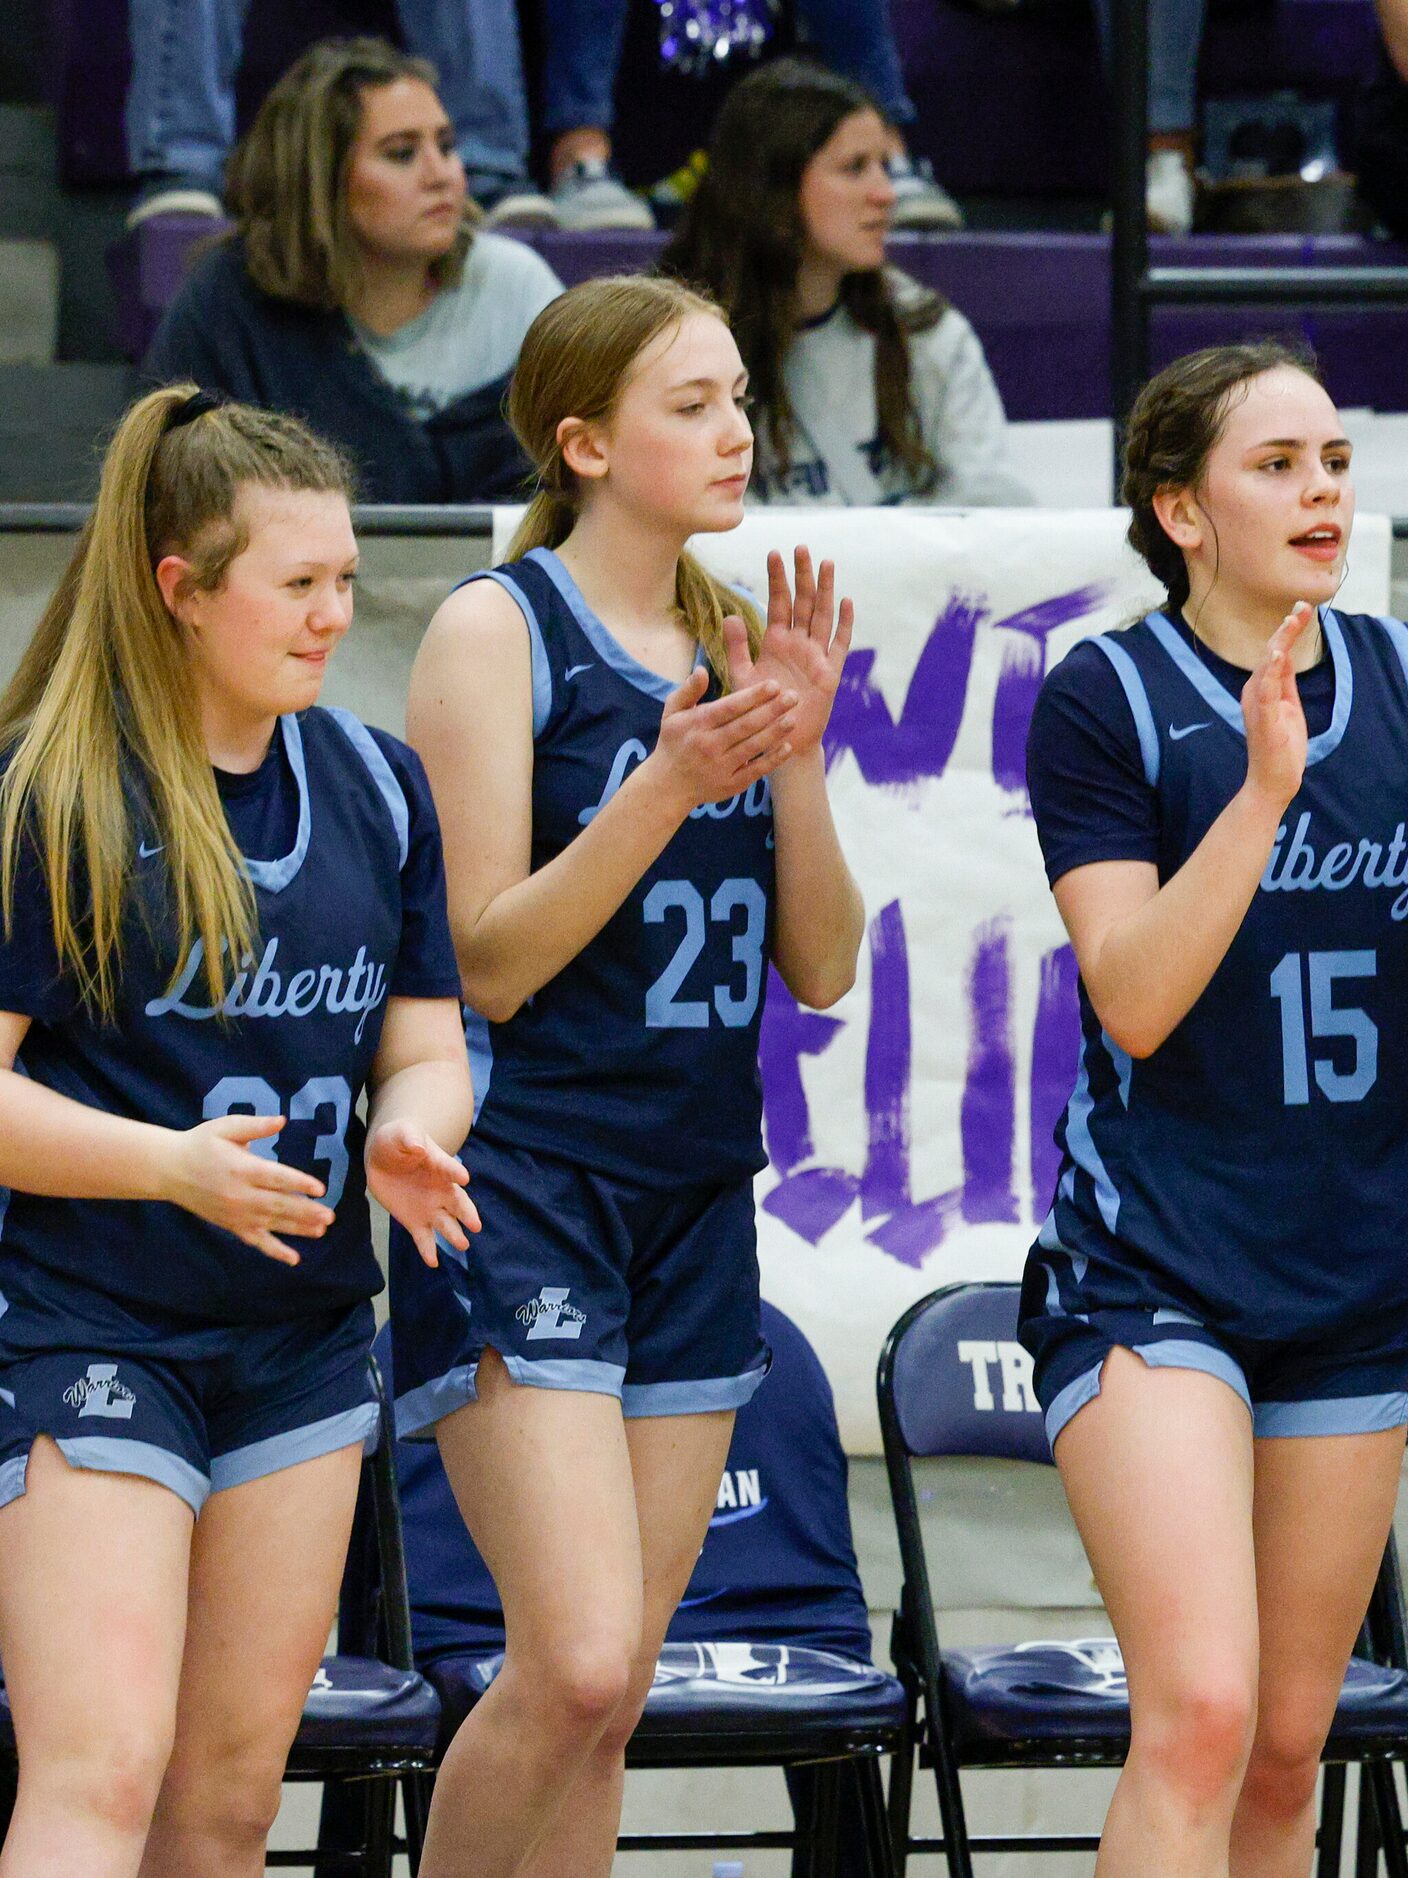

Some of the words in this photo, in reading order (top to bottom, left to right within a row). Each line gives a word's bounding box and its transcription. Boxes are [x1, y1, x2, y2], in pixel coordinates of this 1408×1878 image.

[144, 936, 387, 1046] Liberty
[643, 878, 767, 1029] 23
[1270, 949, 1378, 1105] 15
